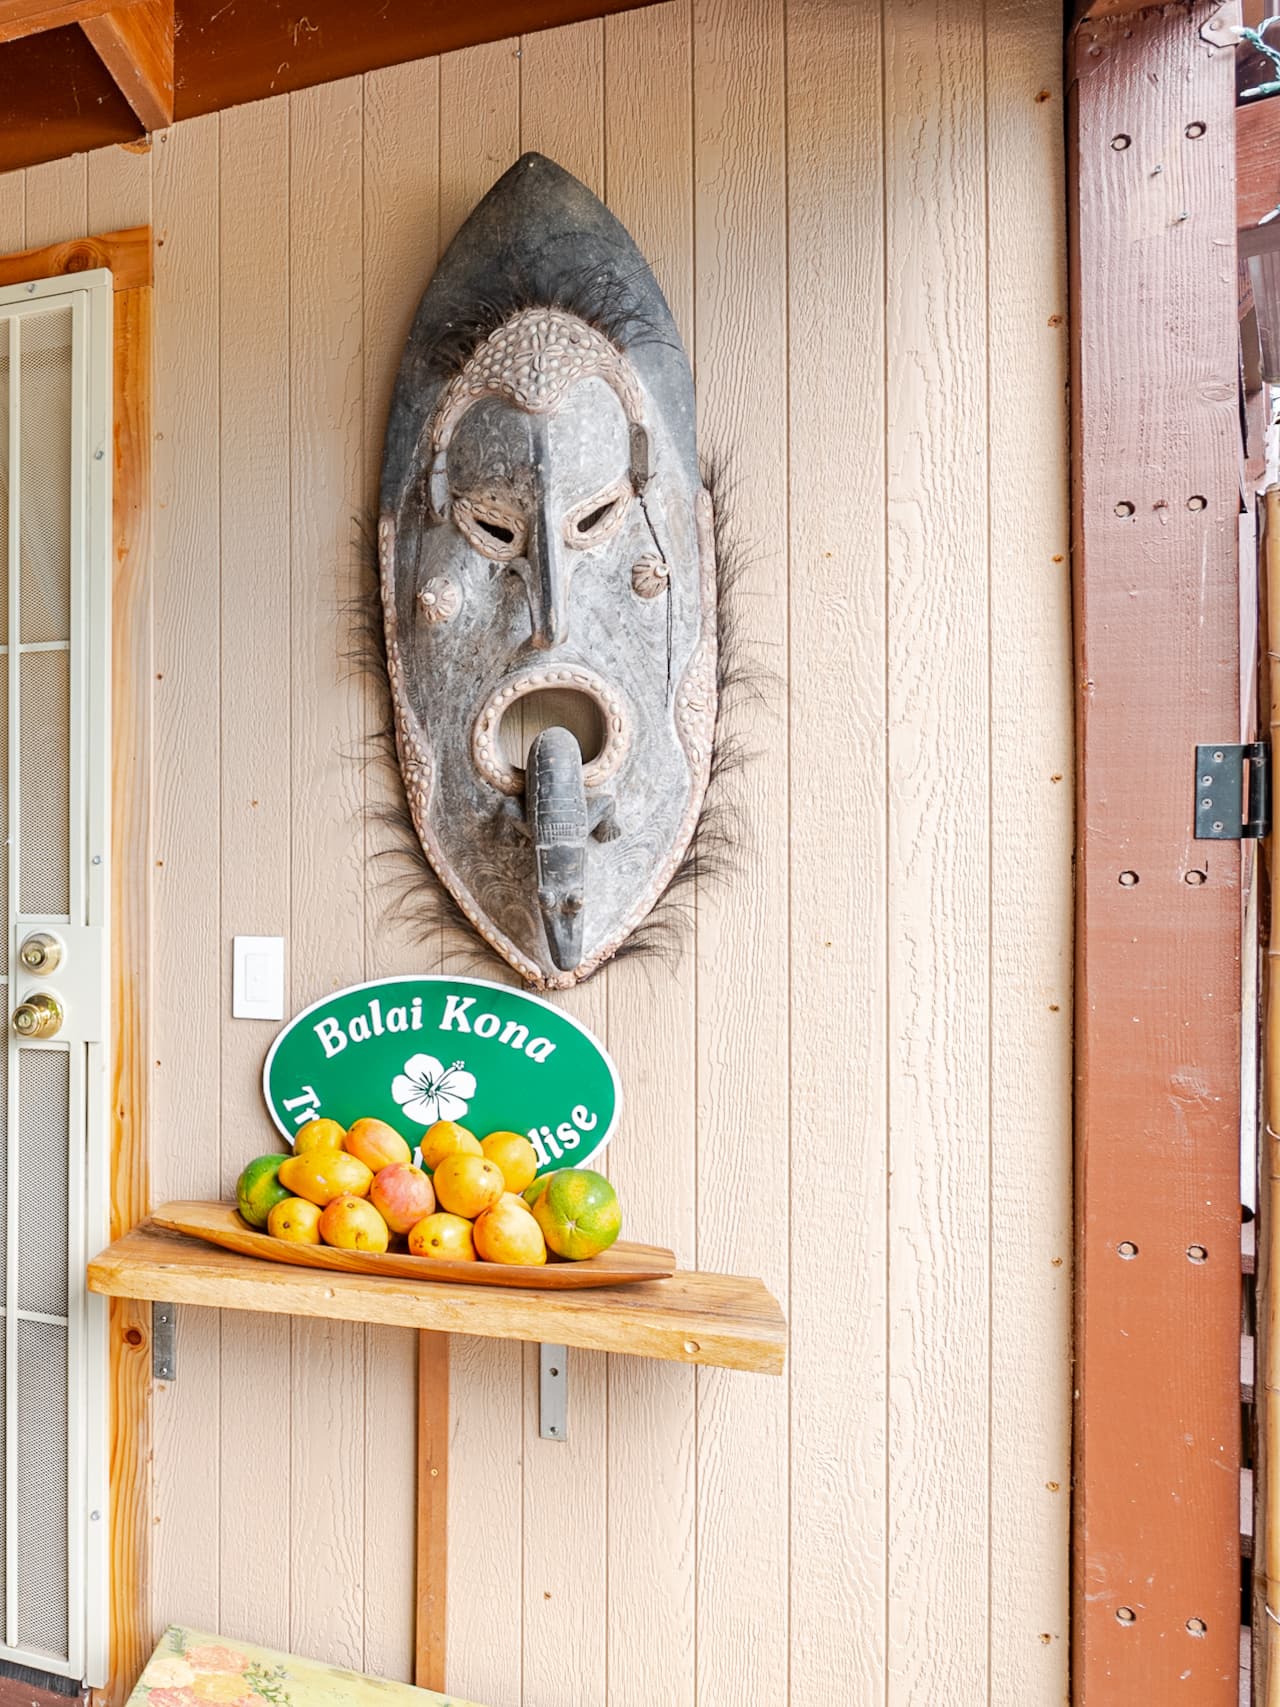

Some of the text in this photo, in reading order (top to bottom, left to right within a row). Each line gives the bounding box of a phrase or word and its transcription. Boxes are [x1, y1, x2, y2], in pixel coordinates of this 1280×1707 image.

[313, 995, 557, 1063] Balai Kona
[528, 1104, 598, 1168] dise
